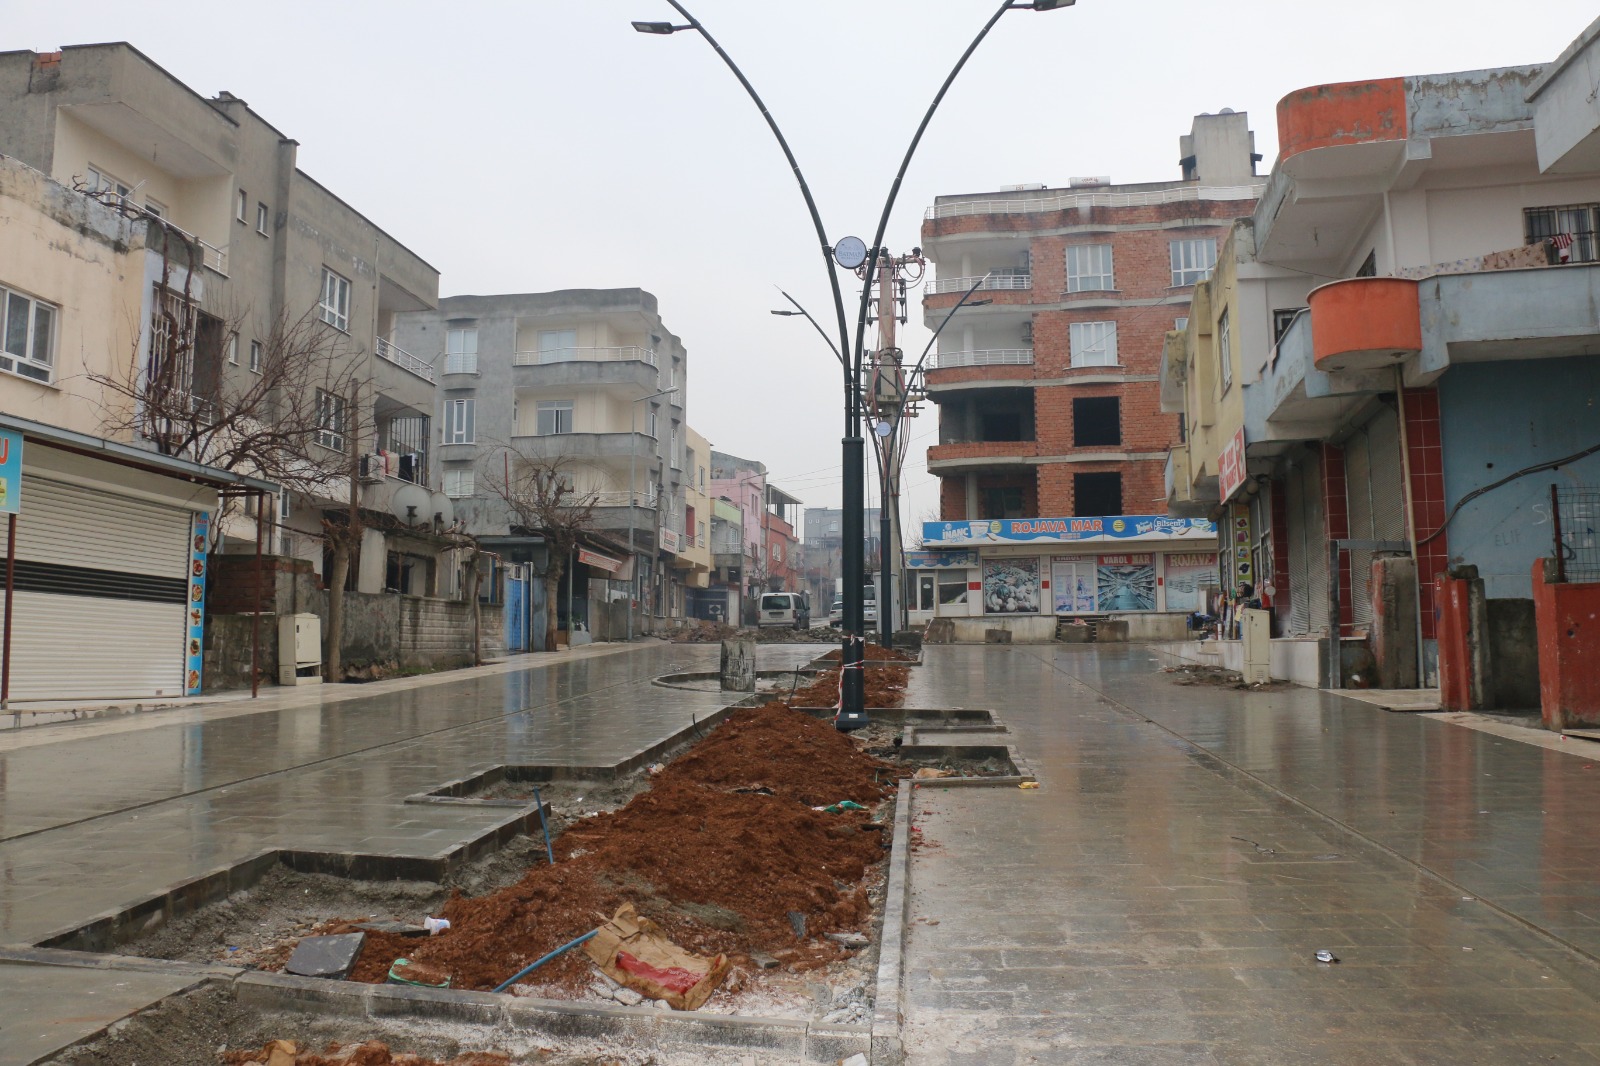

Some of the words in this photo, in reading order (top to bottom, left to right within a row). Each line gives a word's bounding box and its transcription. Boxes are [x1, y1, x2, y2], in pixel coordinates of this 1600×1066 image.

[1011, 521, 1068, 534] ROJAVA
[1071, 519, 1103, 532] MAR
[1103, 556, 1128, 564] VAROL
[1132, 555, 1150, 564] MAR
[1170, 555, 1213, 567] ROJAVA
